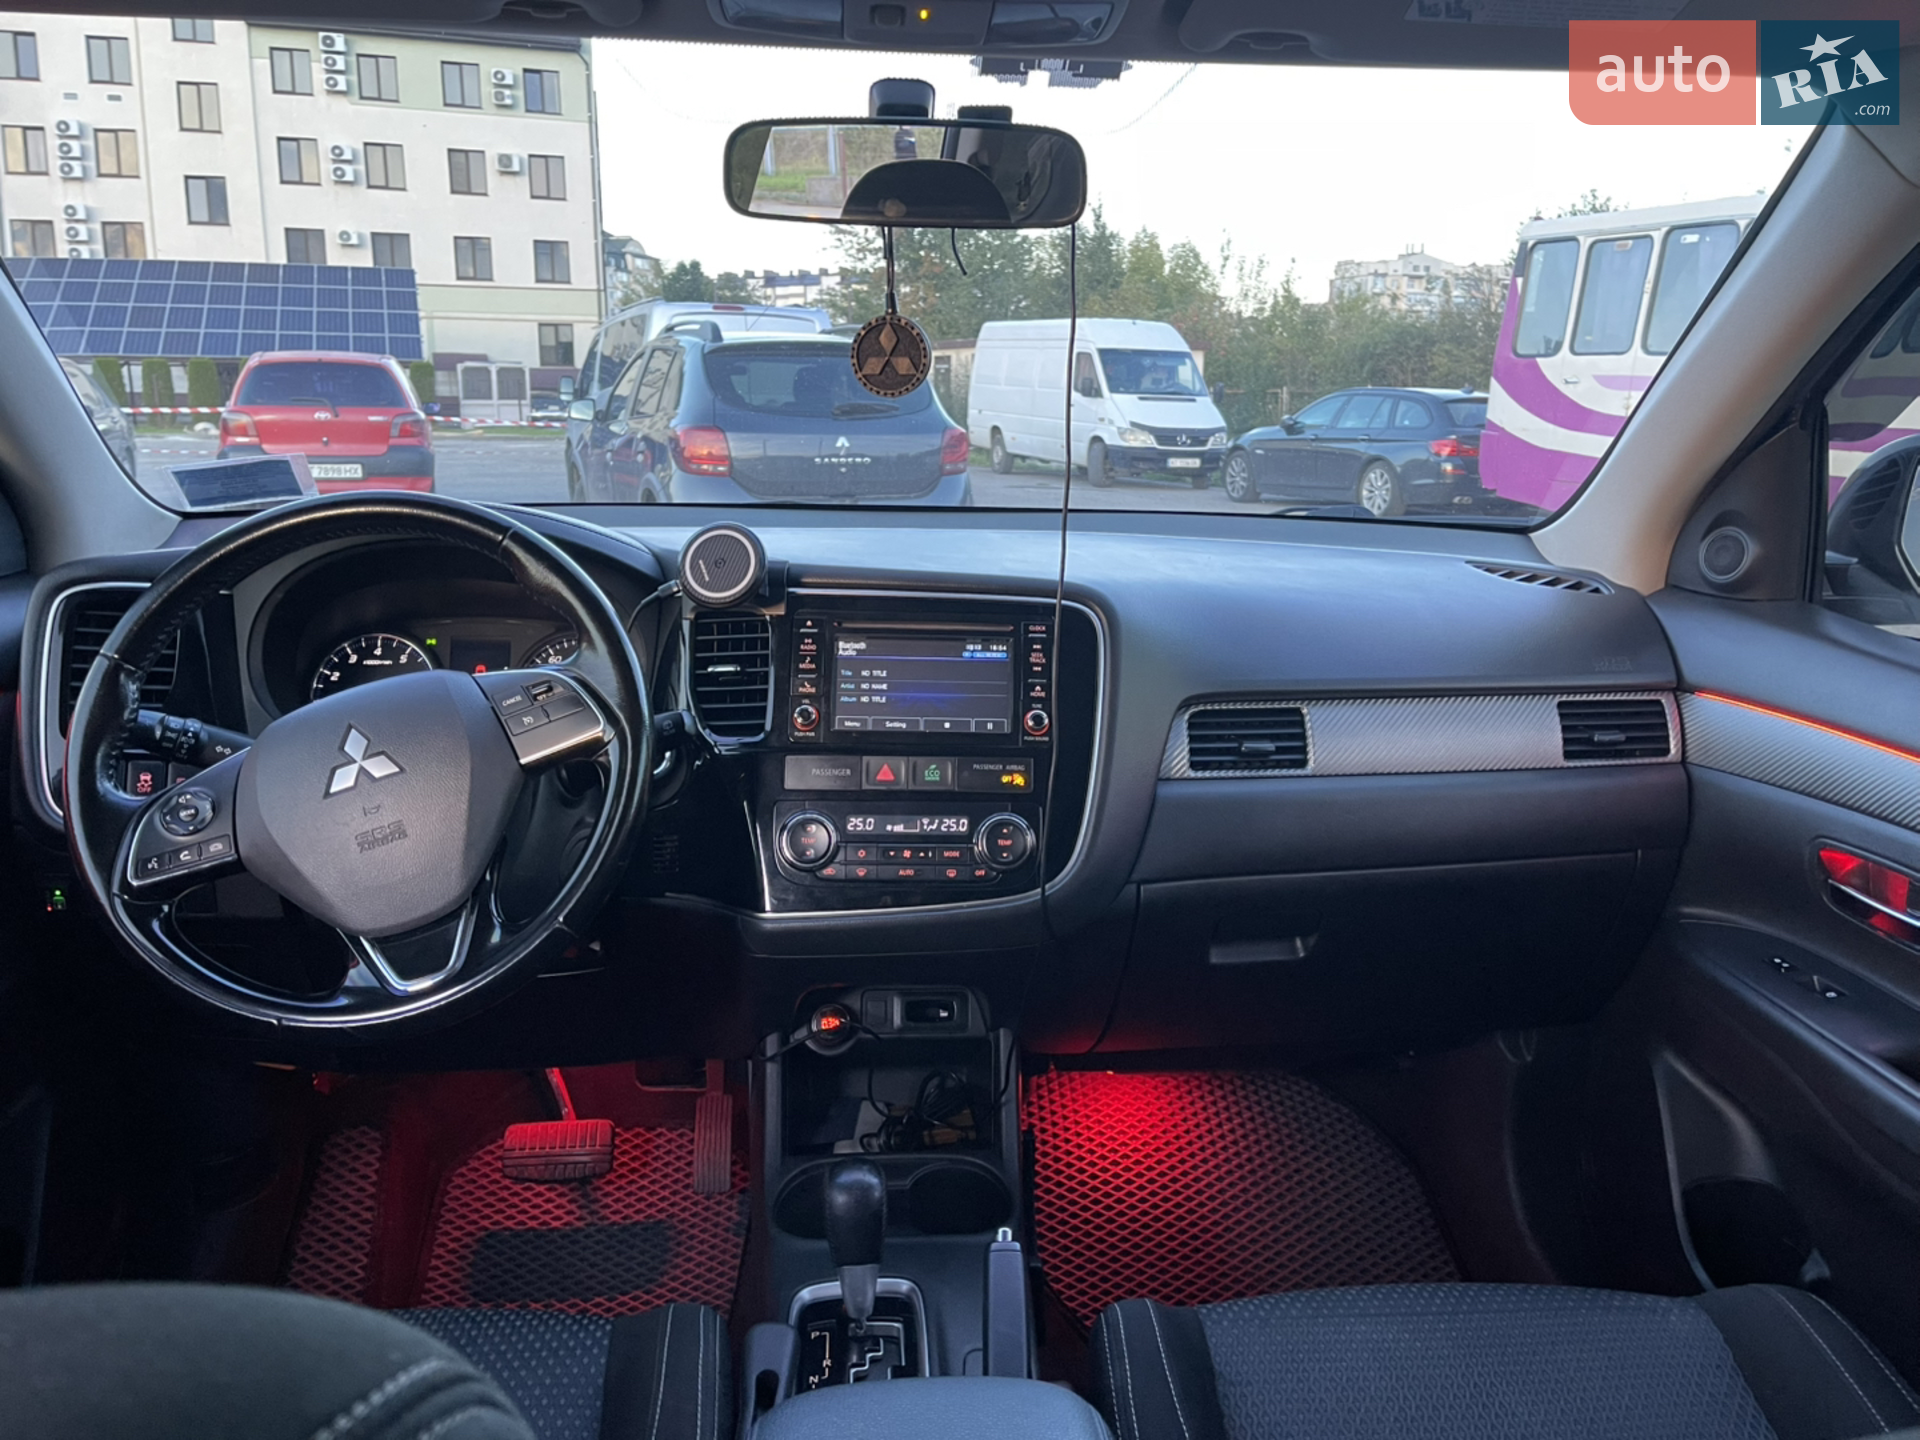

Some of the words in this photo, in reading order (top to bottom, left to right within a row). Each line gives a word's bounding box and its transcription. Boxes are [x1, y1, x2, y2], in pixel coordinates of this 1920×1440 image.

[373, 647, 383, 656] 4
[348, 654, 358, 664] 3
[399, 654, 409, 664] 5
[548, 655, 562, 664] 60
[330, 671, 340, 681] 2
[885, 721, 907, 729] Setting
[812, 768, 851, 776] PASSENGER
[847, 818, 874, 830] 25.0
[941, 819, 968, 831] 25.0
[811, 1331, 820, 1340] P
[809, 1375, 819, 1384] N
